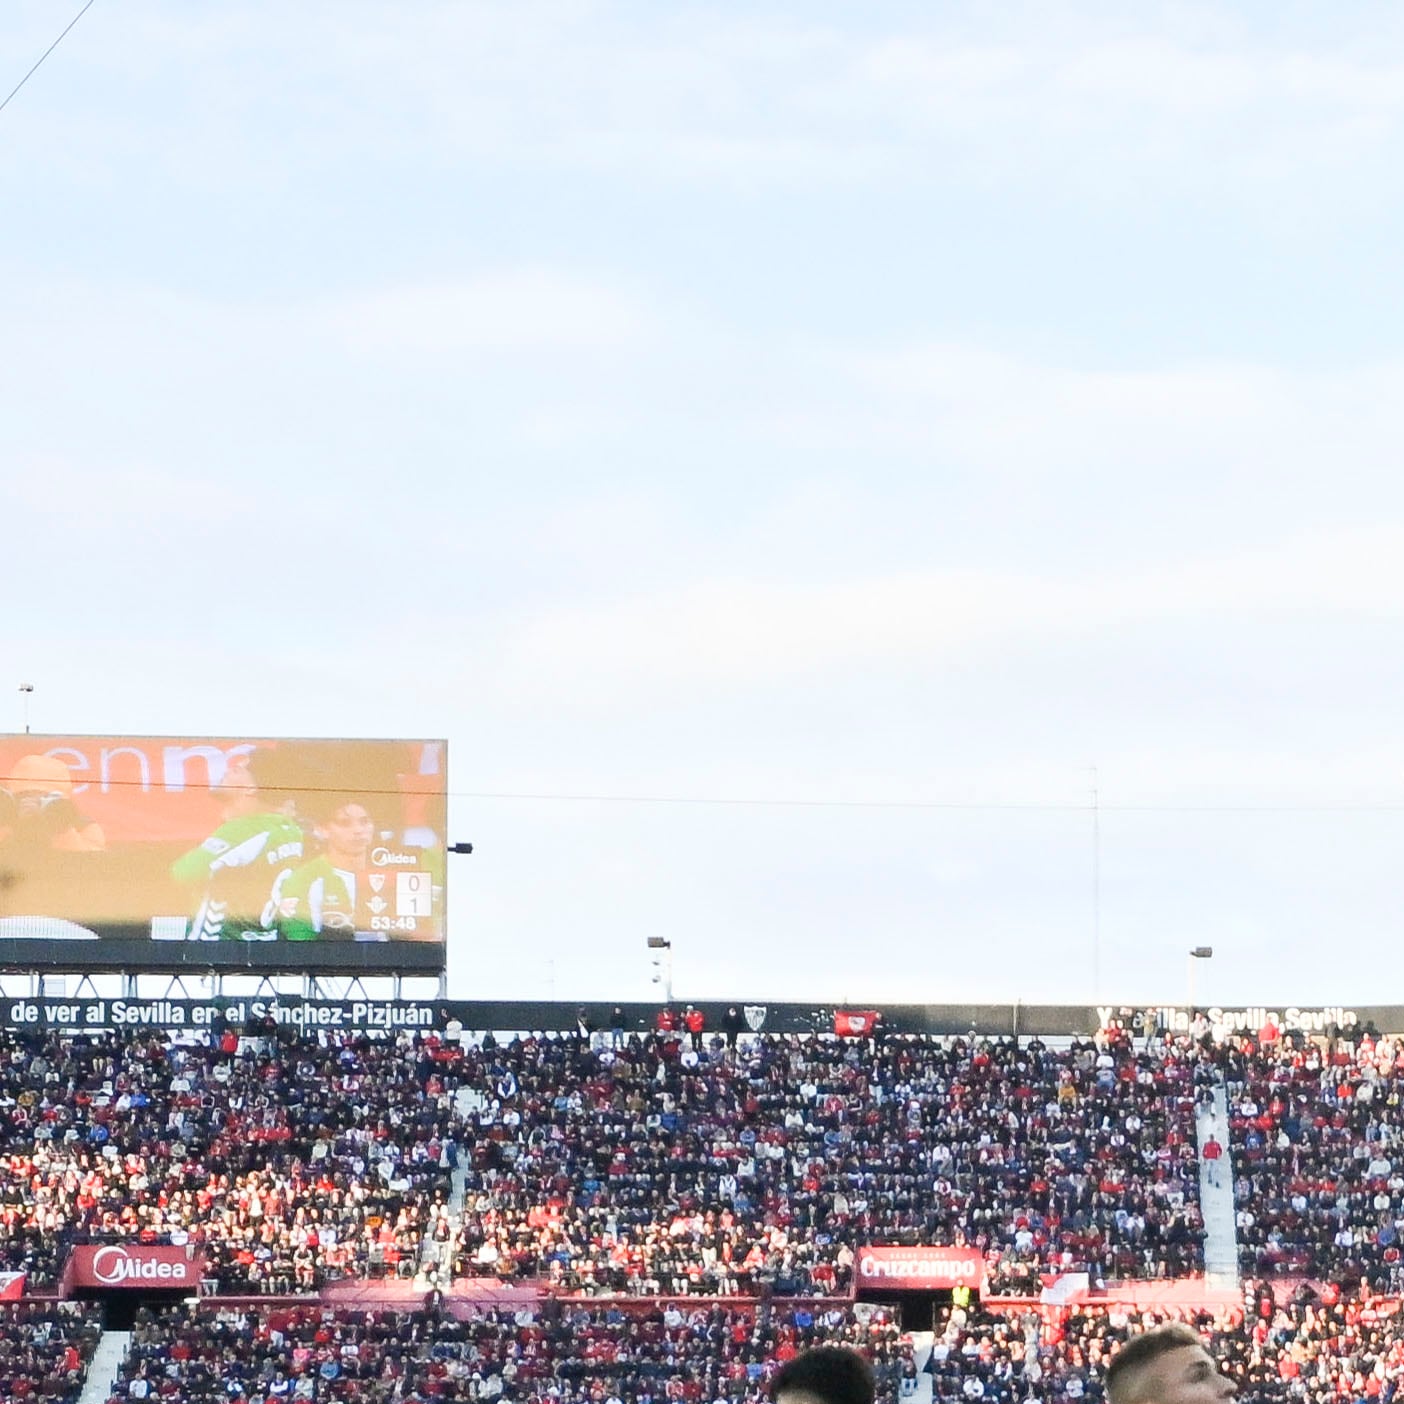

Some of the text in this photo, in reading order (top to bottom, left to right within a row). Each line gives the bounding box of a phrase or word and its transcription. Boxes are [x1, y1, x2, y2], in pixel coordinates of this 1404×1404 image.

[408, 875, 420, 892] 0
[409, 899, 418, 914] 1
[370, 916, 417, 931] 53:48
[10, 1001, 38, 1024] de
[44, 1006, 79, 1024] ver
[86, 1001, 105, 1024] al
[111, 1001, 185, 1024] Sevilla
[226, 1001, 245, 1023] el
[100, 1253, 187, 1280] Midea
[860, 1255, 977, 1280] Cruzcampo
